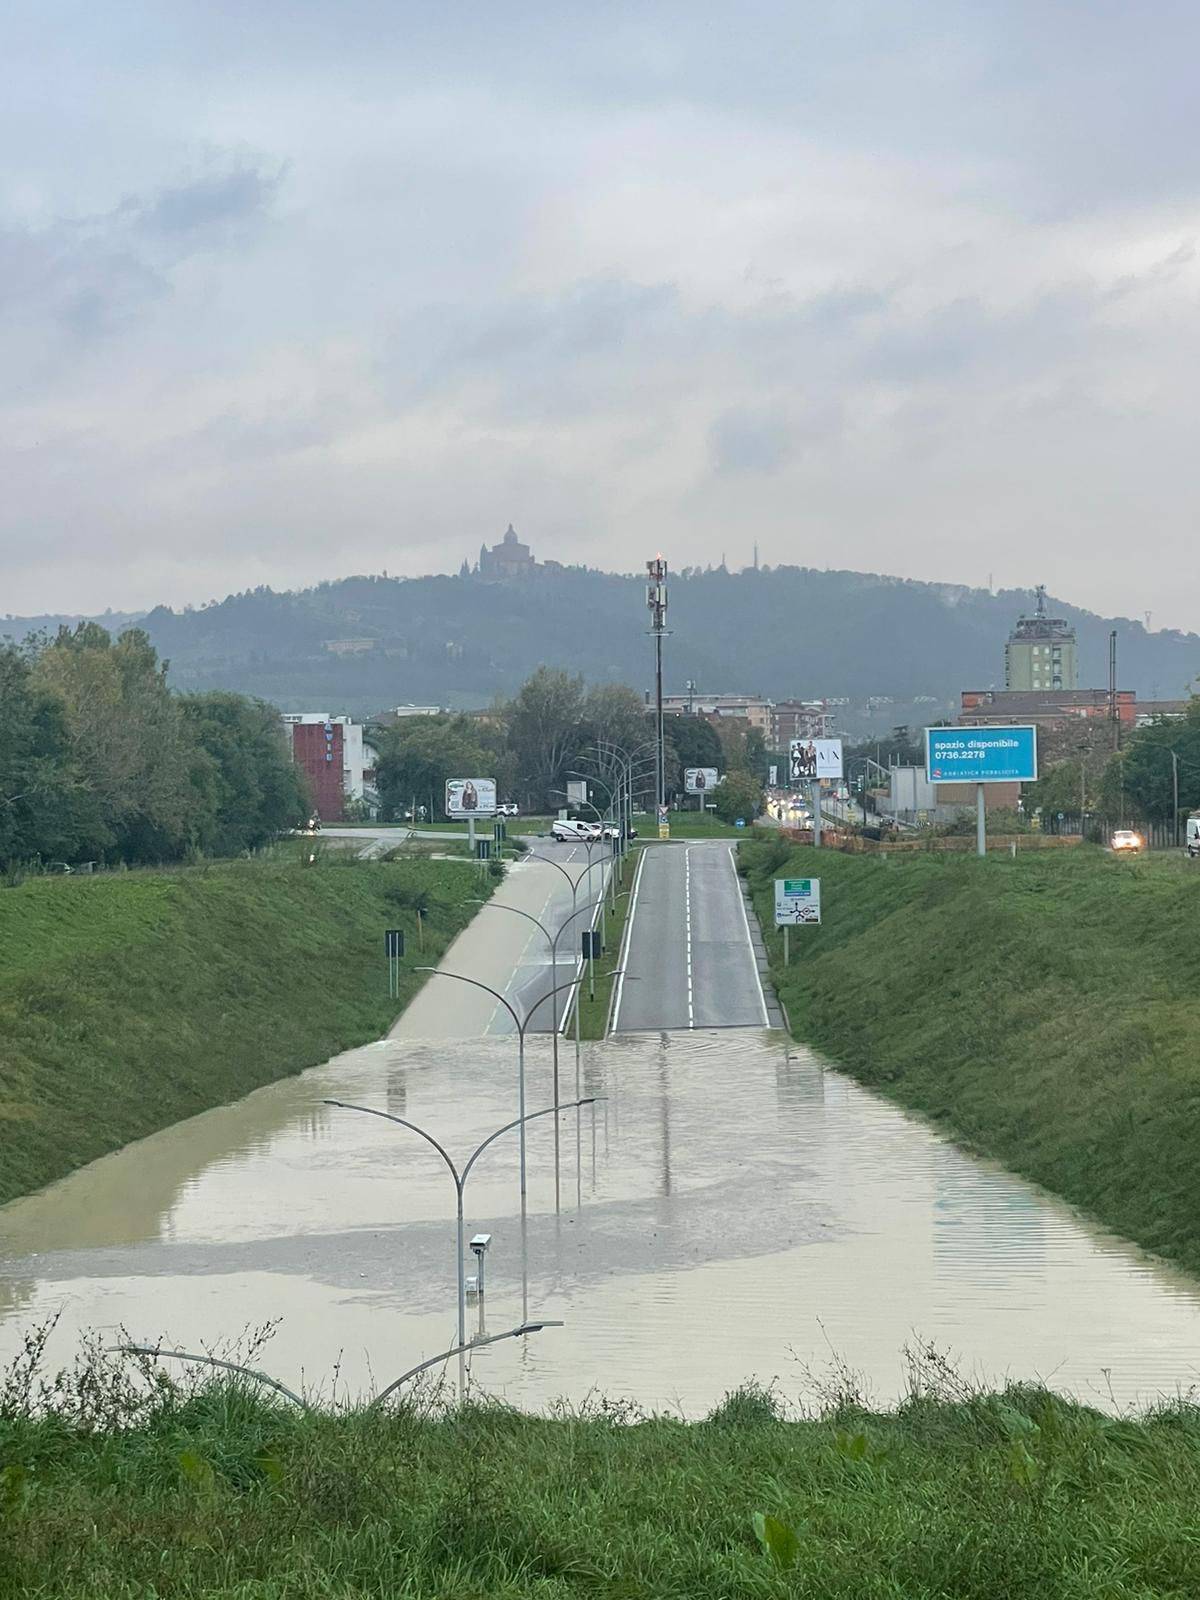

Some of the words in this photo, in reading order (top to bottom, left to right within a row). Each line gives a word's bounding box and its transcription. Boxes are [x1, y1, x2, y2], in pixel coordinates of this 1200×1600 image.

[934, 740, 965, 750] spazio
[967, 739, 1019, 749] disponibile
[935, 751, 985, 759] 0736.2278
